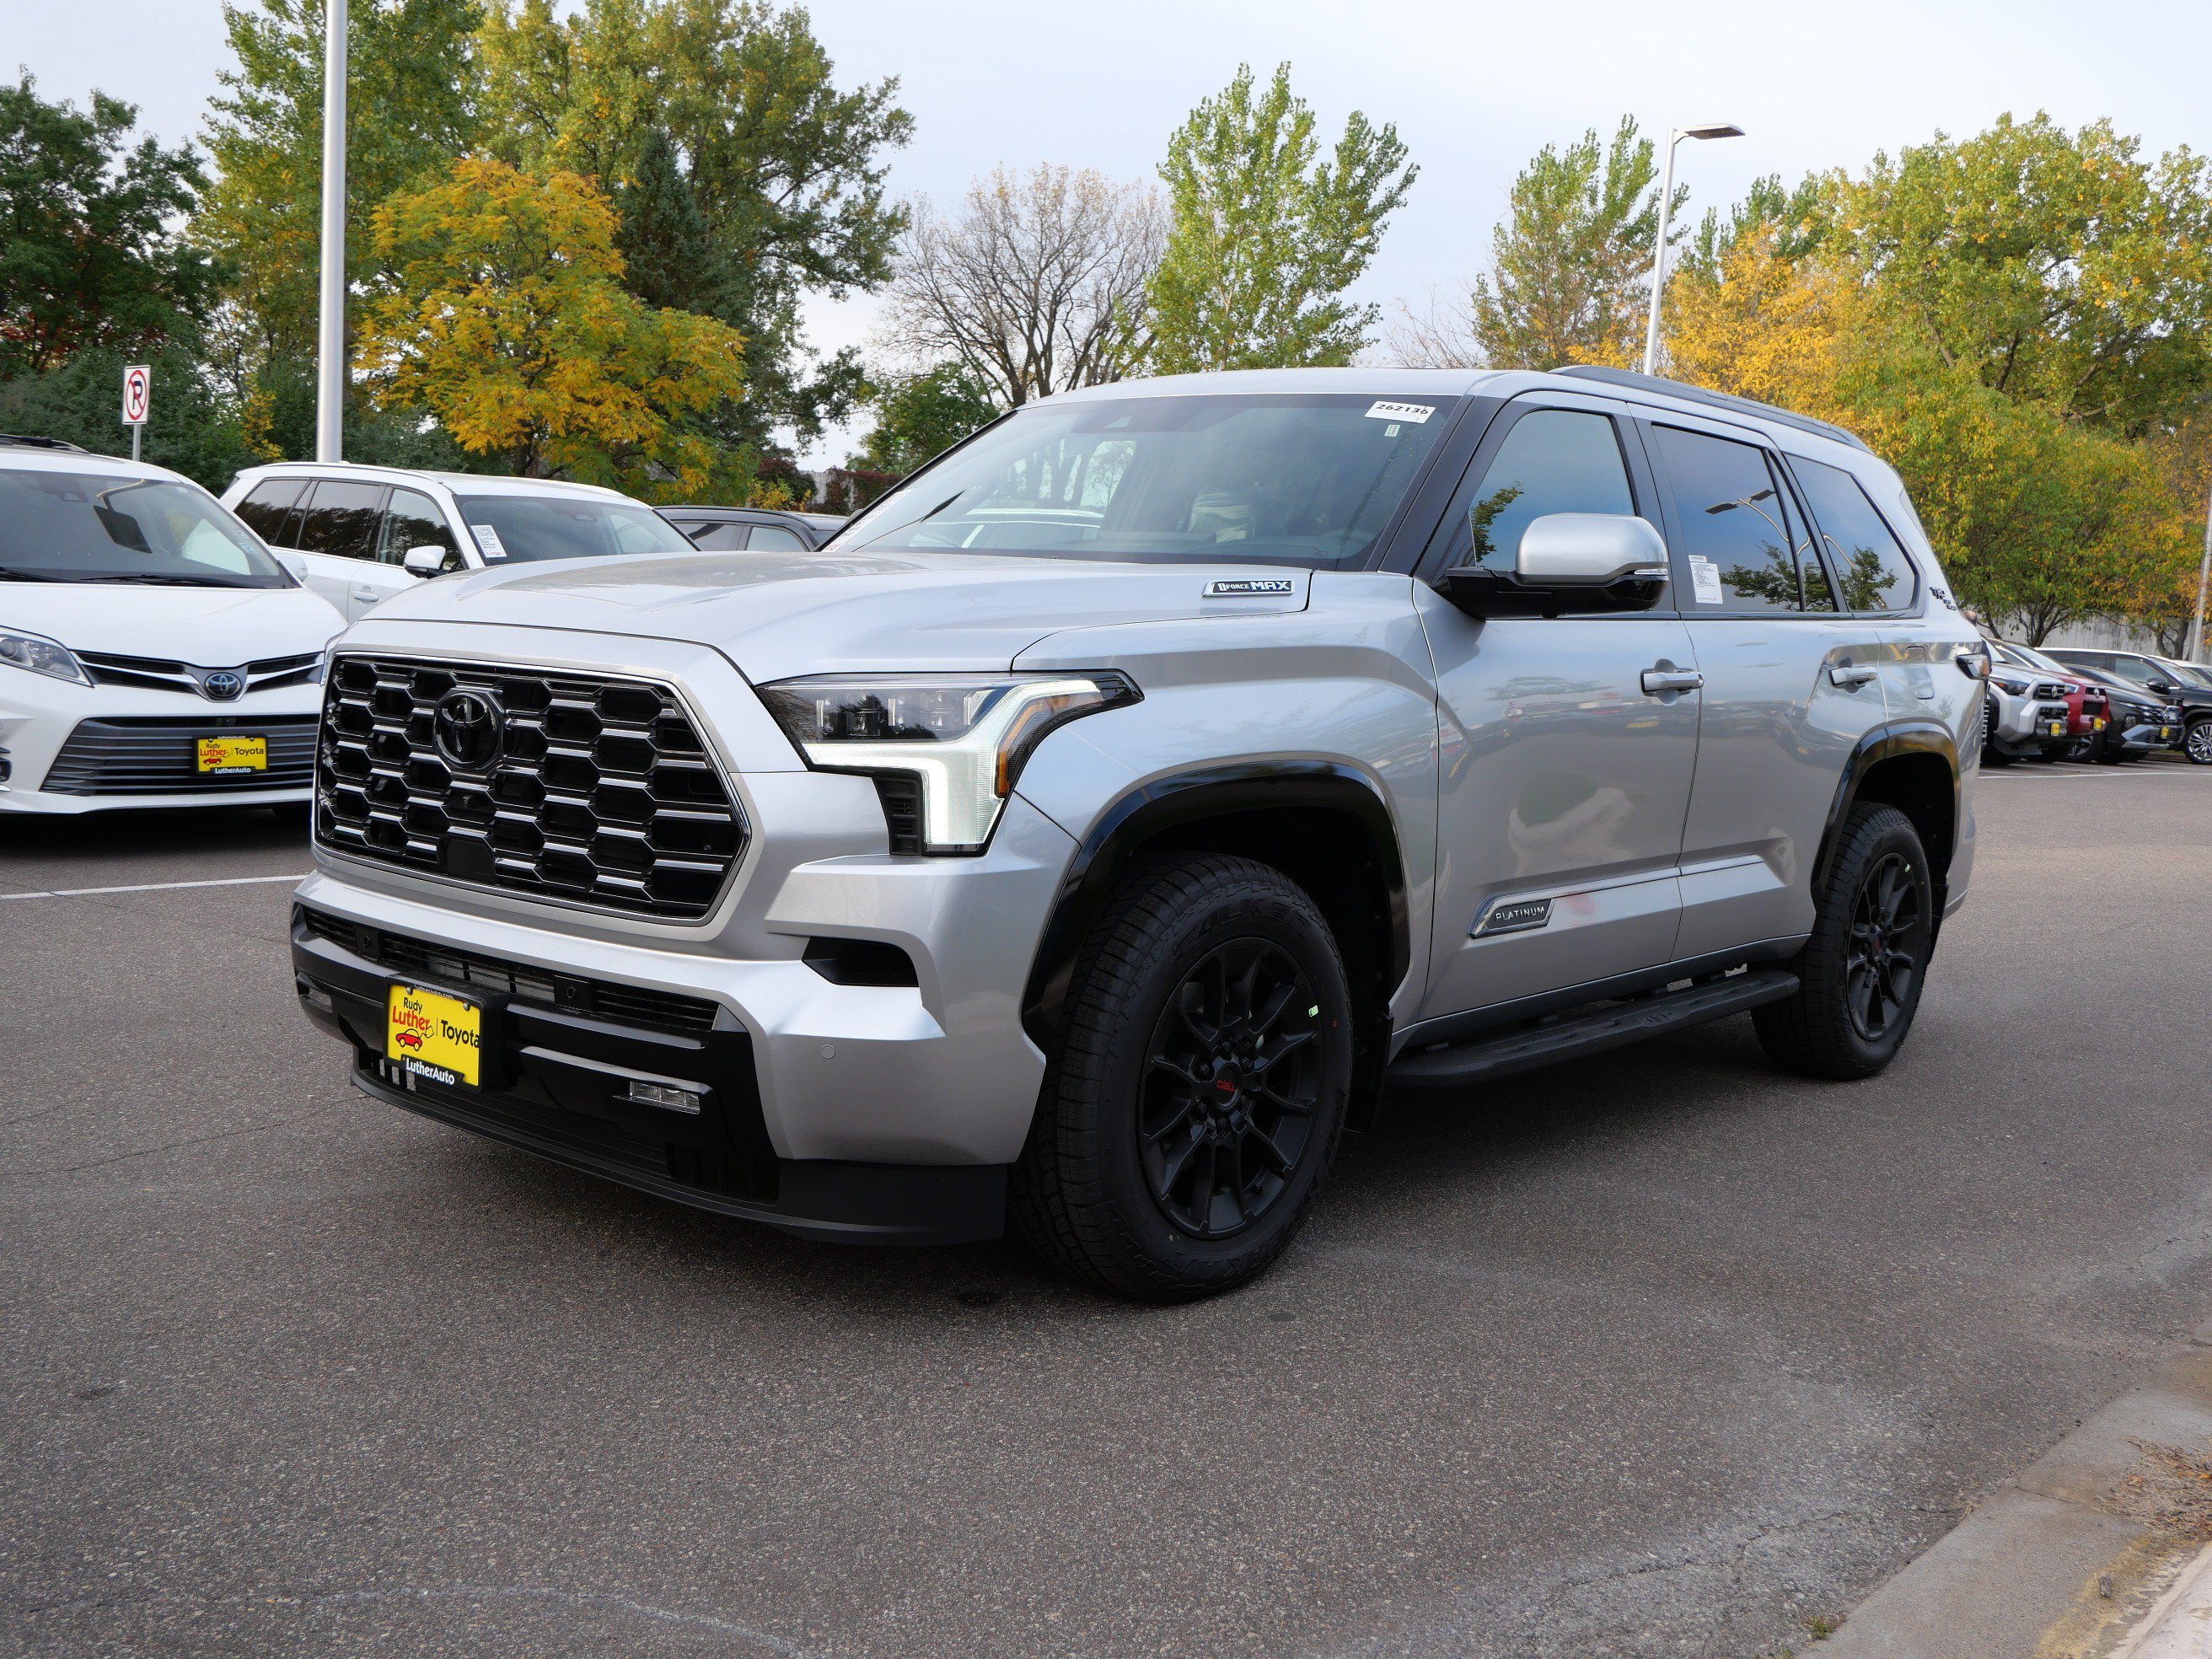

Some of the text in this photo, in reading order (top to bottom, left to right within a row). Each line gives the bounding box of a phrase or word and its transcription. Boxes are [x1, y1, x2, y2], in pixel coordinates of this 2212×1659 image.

[1376, 404, 1429, 416] 262136
[1249, 581, 1291, 591] MAX
[234, 747, 264, 756] Toyota
[1495, 905, 1544, 921] PLATINUM
[403, 996, 422, 1014] Rudy
[392, 1005, 481, 1049] Luther Toyota
[405, 1057, 455, 1085] LutherAuto
